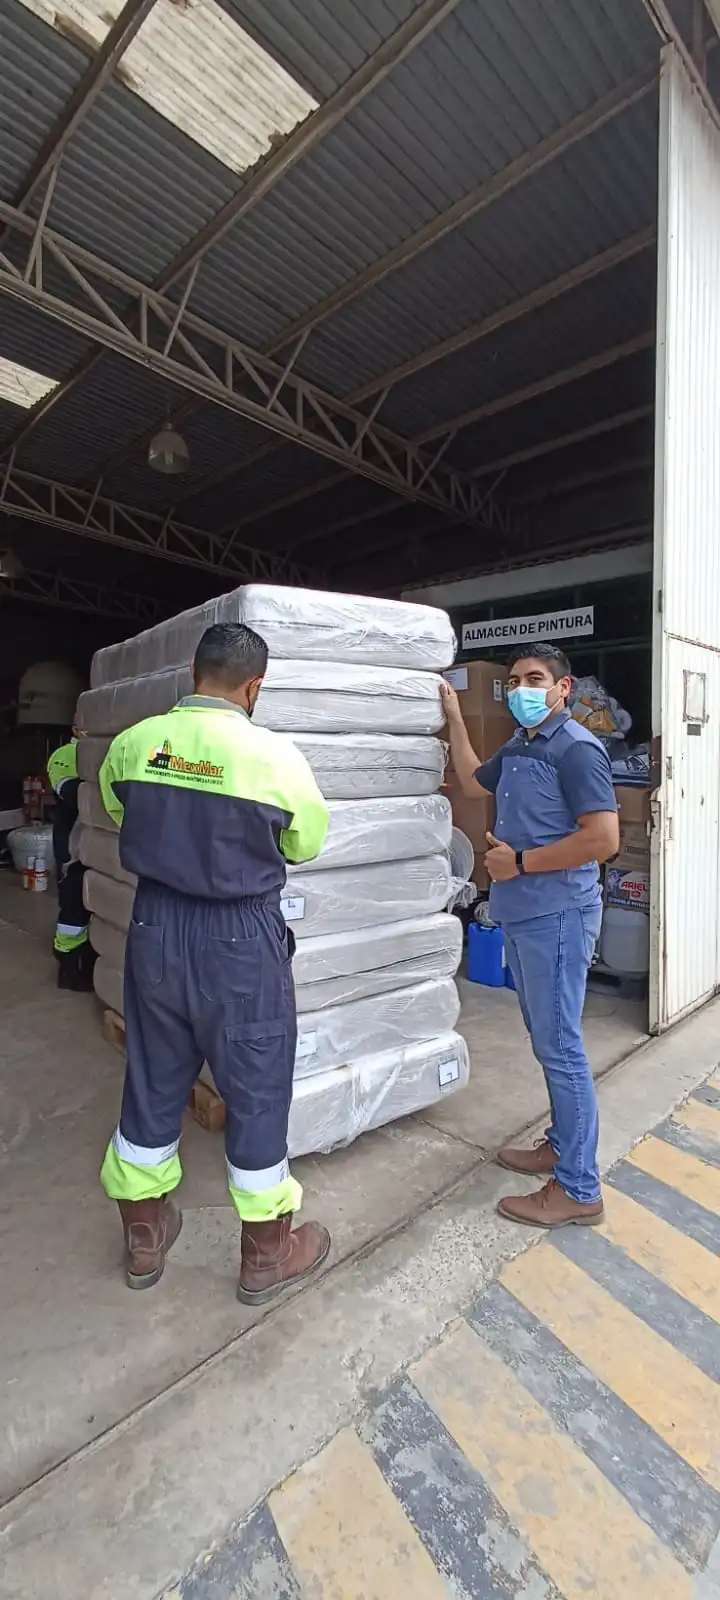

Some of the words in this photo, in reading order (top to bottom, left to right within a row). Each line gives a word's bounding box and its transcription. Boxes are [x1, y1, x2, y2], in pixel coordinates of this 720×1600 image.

[464, 625, 517, 641] ALMACEN
[520, 622, 536, 635] DE
[538, 614, 593, 632] PINTURA
[170, 755, 224, 776] MexMar
[621, 881, 647, 892] ARIEL
